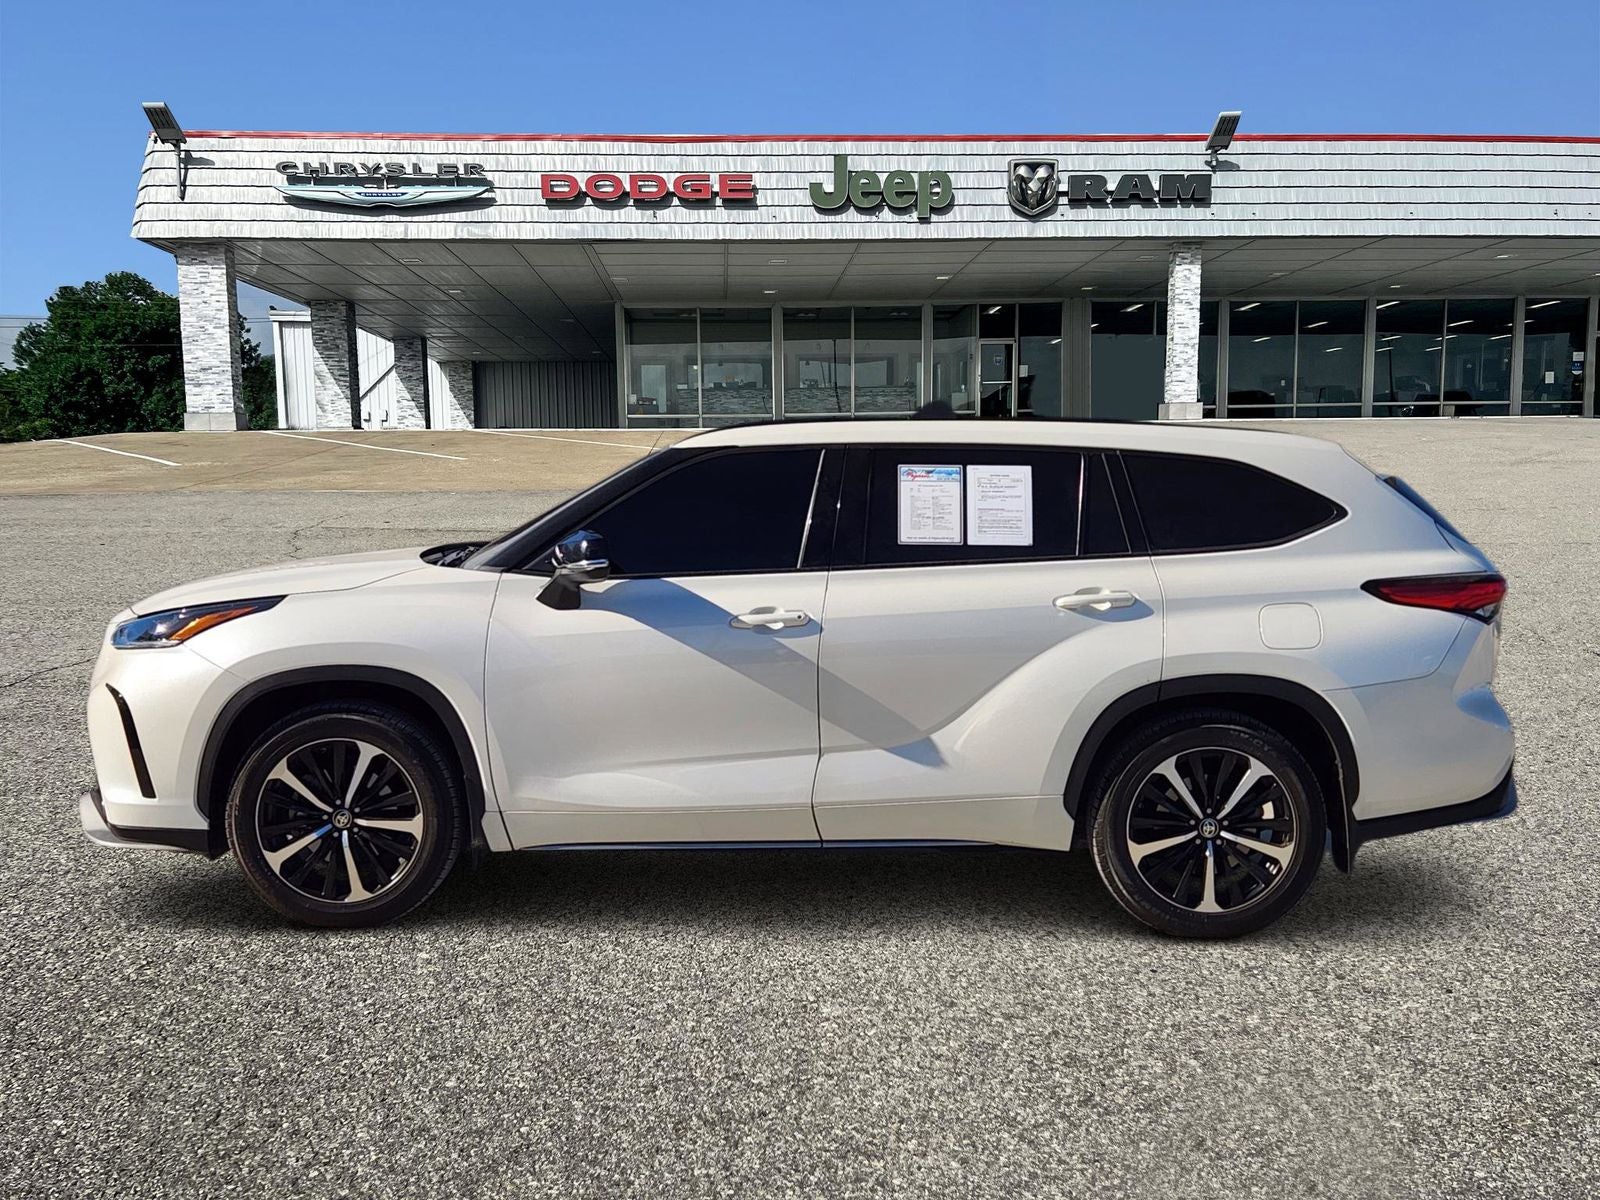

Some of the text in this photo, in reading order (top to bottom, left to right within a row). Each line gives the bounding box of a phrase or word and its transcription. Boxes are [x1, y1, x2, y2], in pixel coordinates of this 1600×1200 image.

[275, 160, 486, 178] CHRYSLER
[541, 173, 755, 200] DODGE
[809, 155, 953, 219] Jeep
[1068, 174, 1212, 199] RAM
